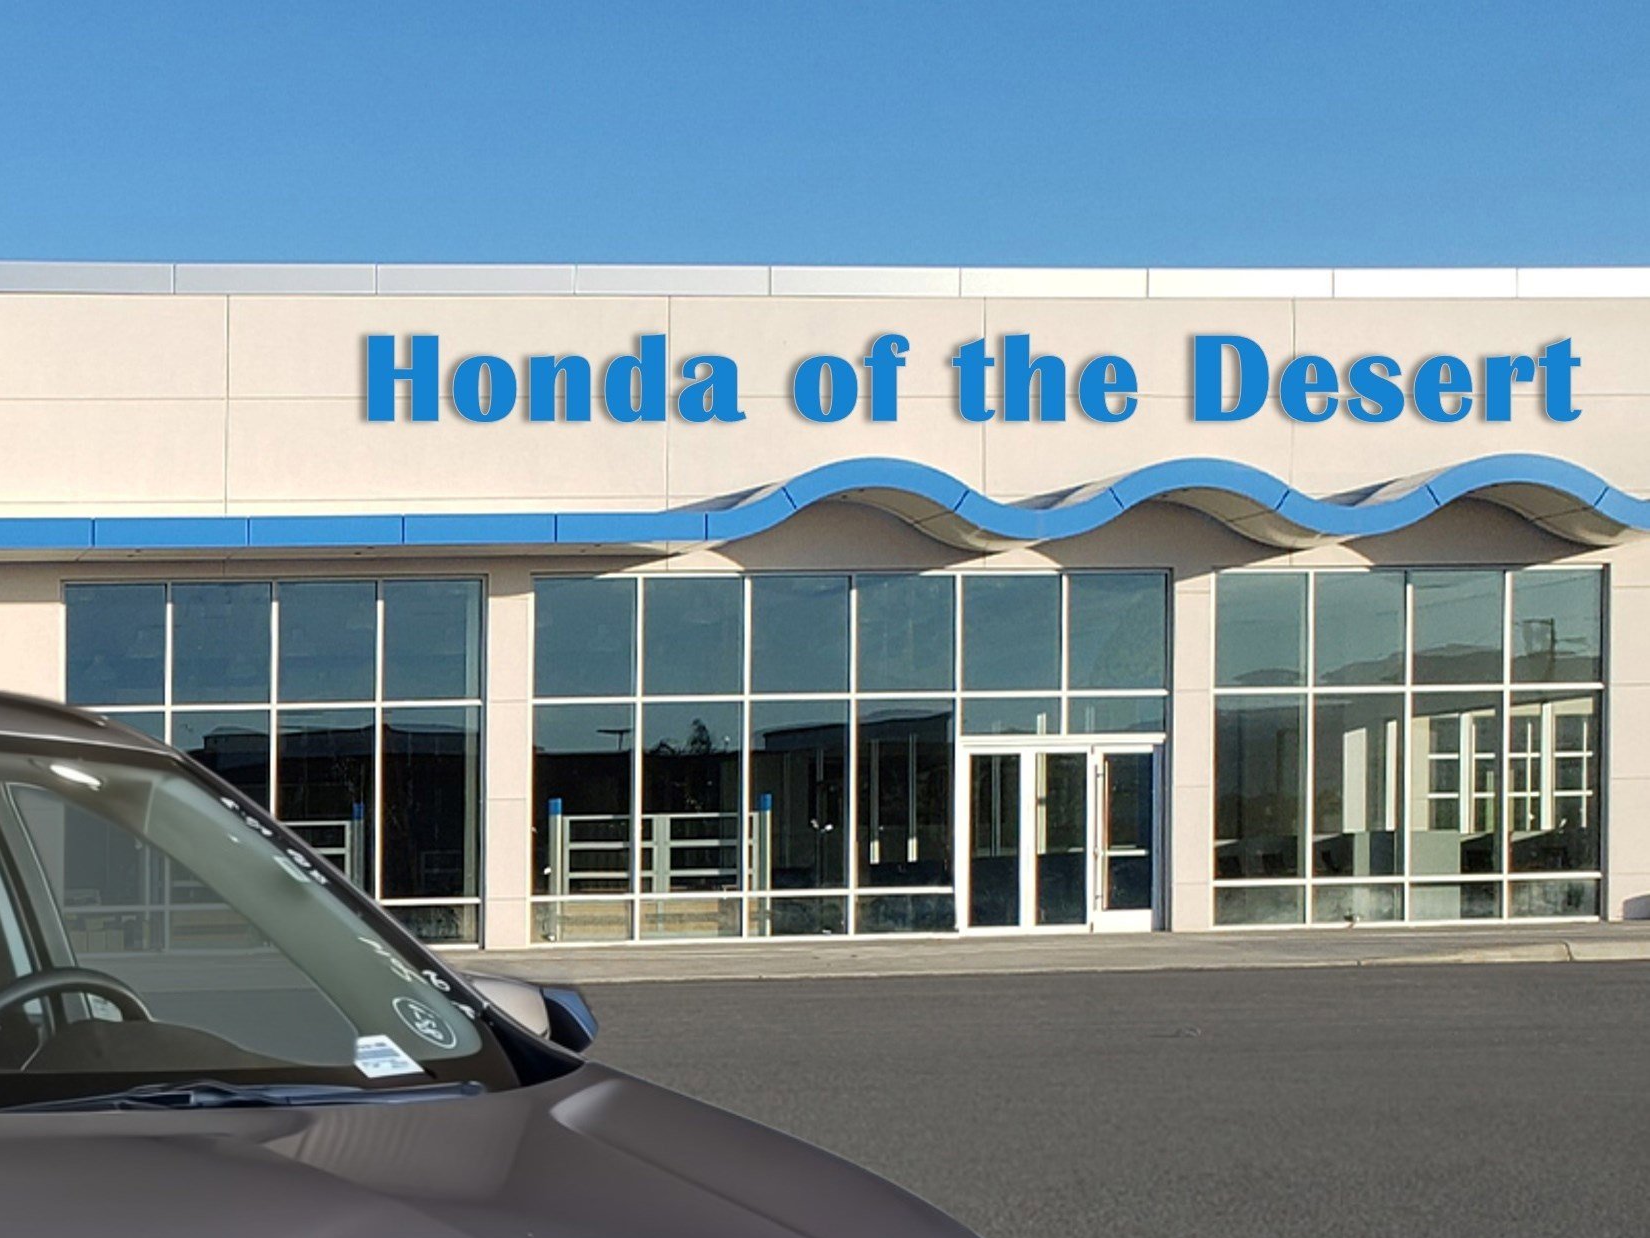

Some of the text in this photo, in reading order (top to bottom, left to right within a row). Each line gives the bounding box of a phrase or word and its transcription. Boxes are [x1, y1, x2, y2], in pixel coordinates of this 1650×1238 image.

[365, 333, 1583, 423] Honda of the Desert
